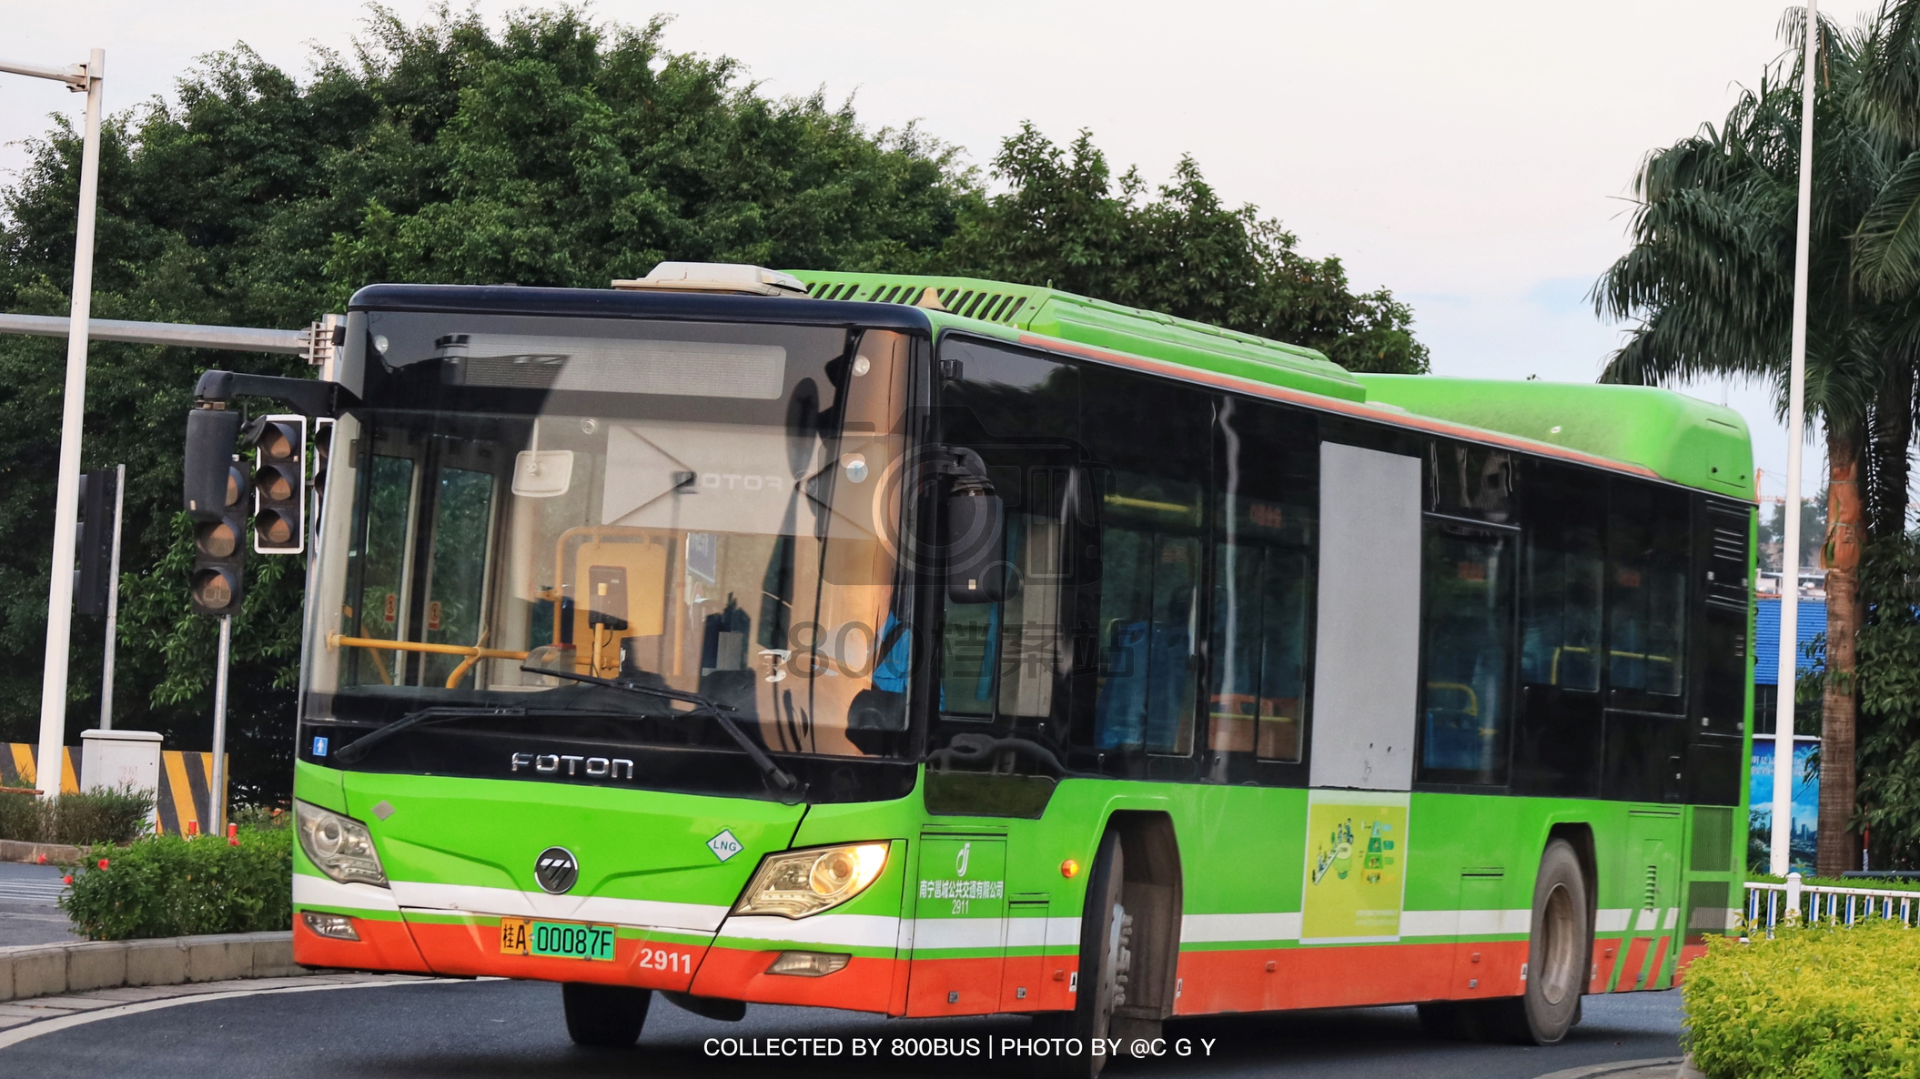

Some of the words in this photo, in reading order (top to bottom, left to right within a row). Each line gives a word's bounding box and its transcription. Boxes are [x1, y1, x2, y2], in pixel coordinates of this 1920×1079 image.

[511, 752, 634, 779] FOTON
[713, 840, 737, 852] LNG
[951, 899, 969, 915] 2911
[639, 948, 691, 974] 2911
